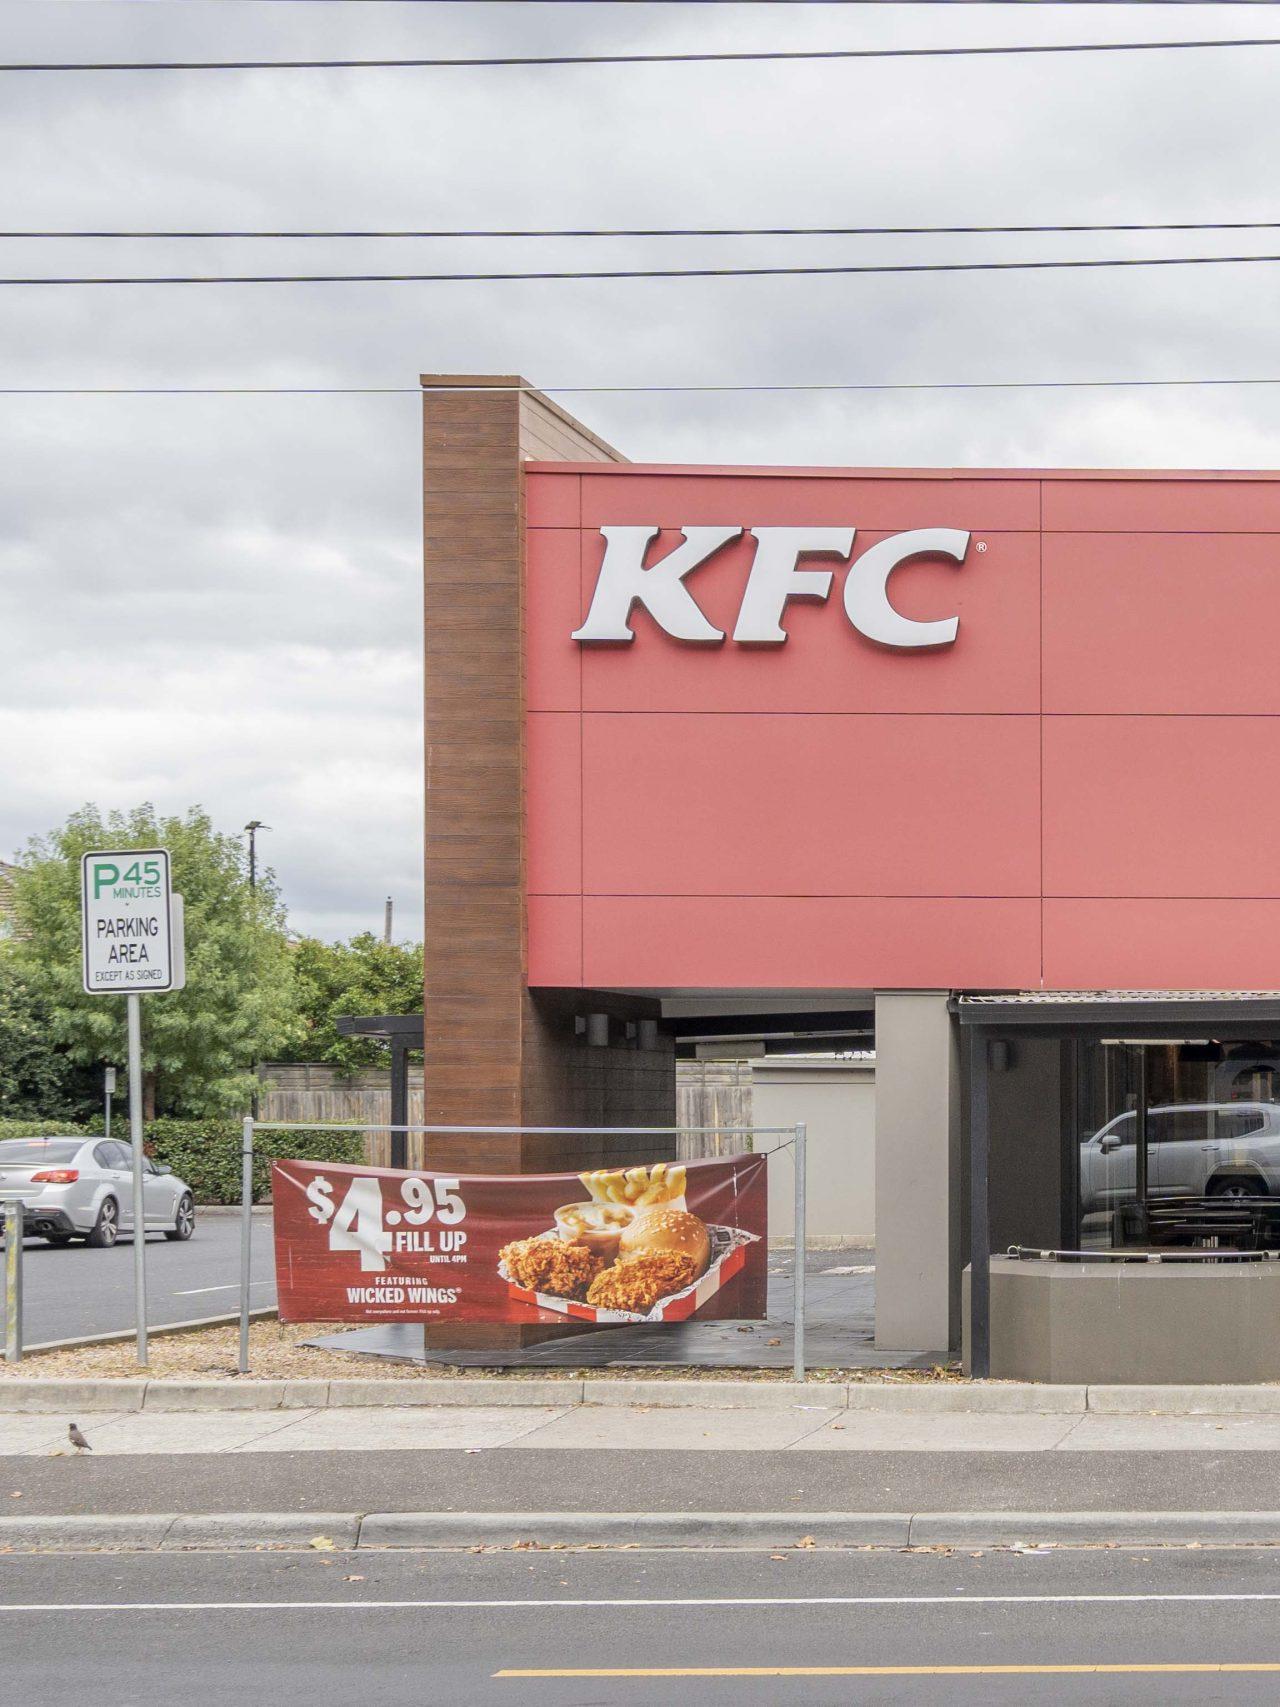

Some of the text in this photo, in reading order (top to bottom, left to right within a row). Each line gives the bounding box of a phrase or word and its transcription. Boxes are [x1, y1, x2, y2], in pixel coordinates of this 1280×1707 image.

[113, 886, 161, 899] MINUTES
[97, 917, 158, 939] PARKING
[108, 943, 149, 963] AREA
[95, 969, 162, 982] EXCEPT AS SIGNED
[306, 1175, 467, 1272] $4.95
[395, 1231, 467, 1252] FILL UP
[429, 1255, 467, 1264] UNTIL 4PM
[375, 1276, 428, 1286] FEATURING
[346, 1287, 404, 1304] WICKED
